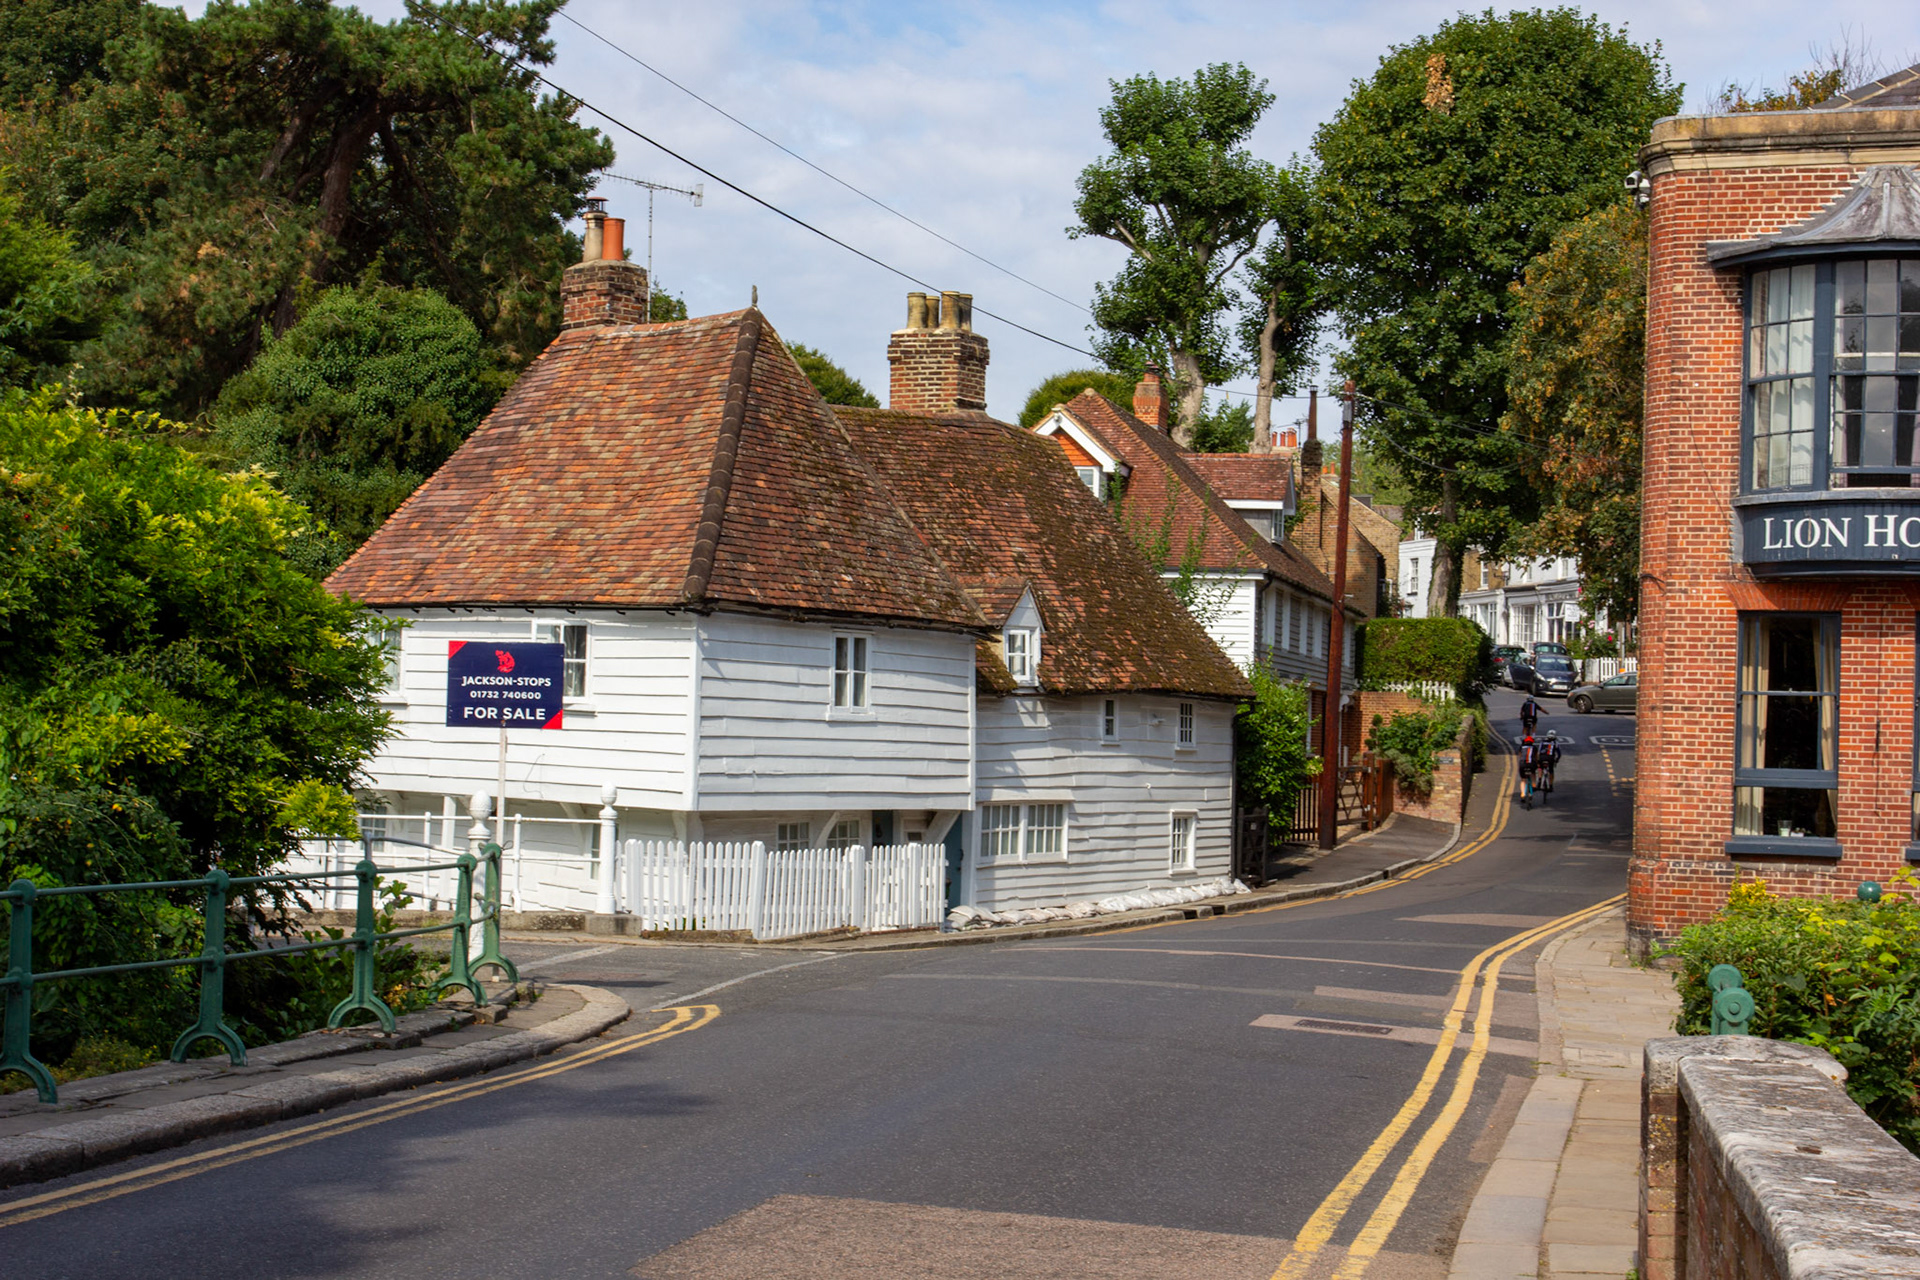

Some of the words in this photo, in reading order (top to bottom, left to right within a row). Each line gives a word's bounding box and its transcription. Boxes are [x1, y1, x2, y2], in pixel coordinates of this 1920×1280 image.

[1763, 517, 1852, 549] LION
[461, 676, 551, 687] JACKSON-STOPS
[470, 690, 499, 698] 01732
[502, 691, 541, 699] 740600
[464, 707, 498, 719] FOR
[503, 708, 546, 720] SALE
